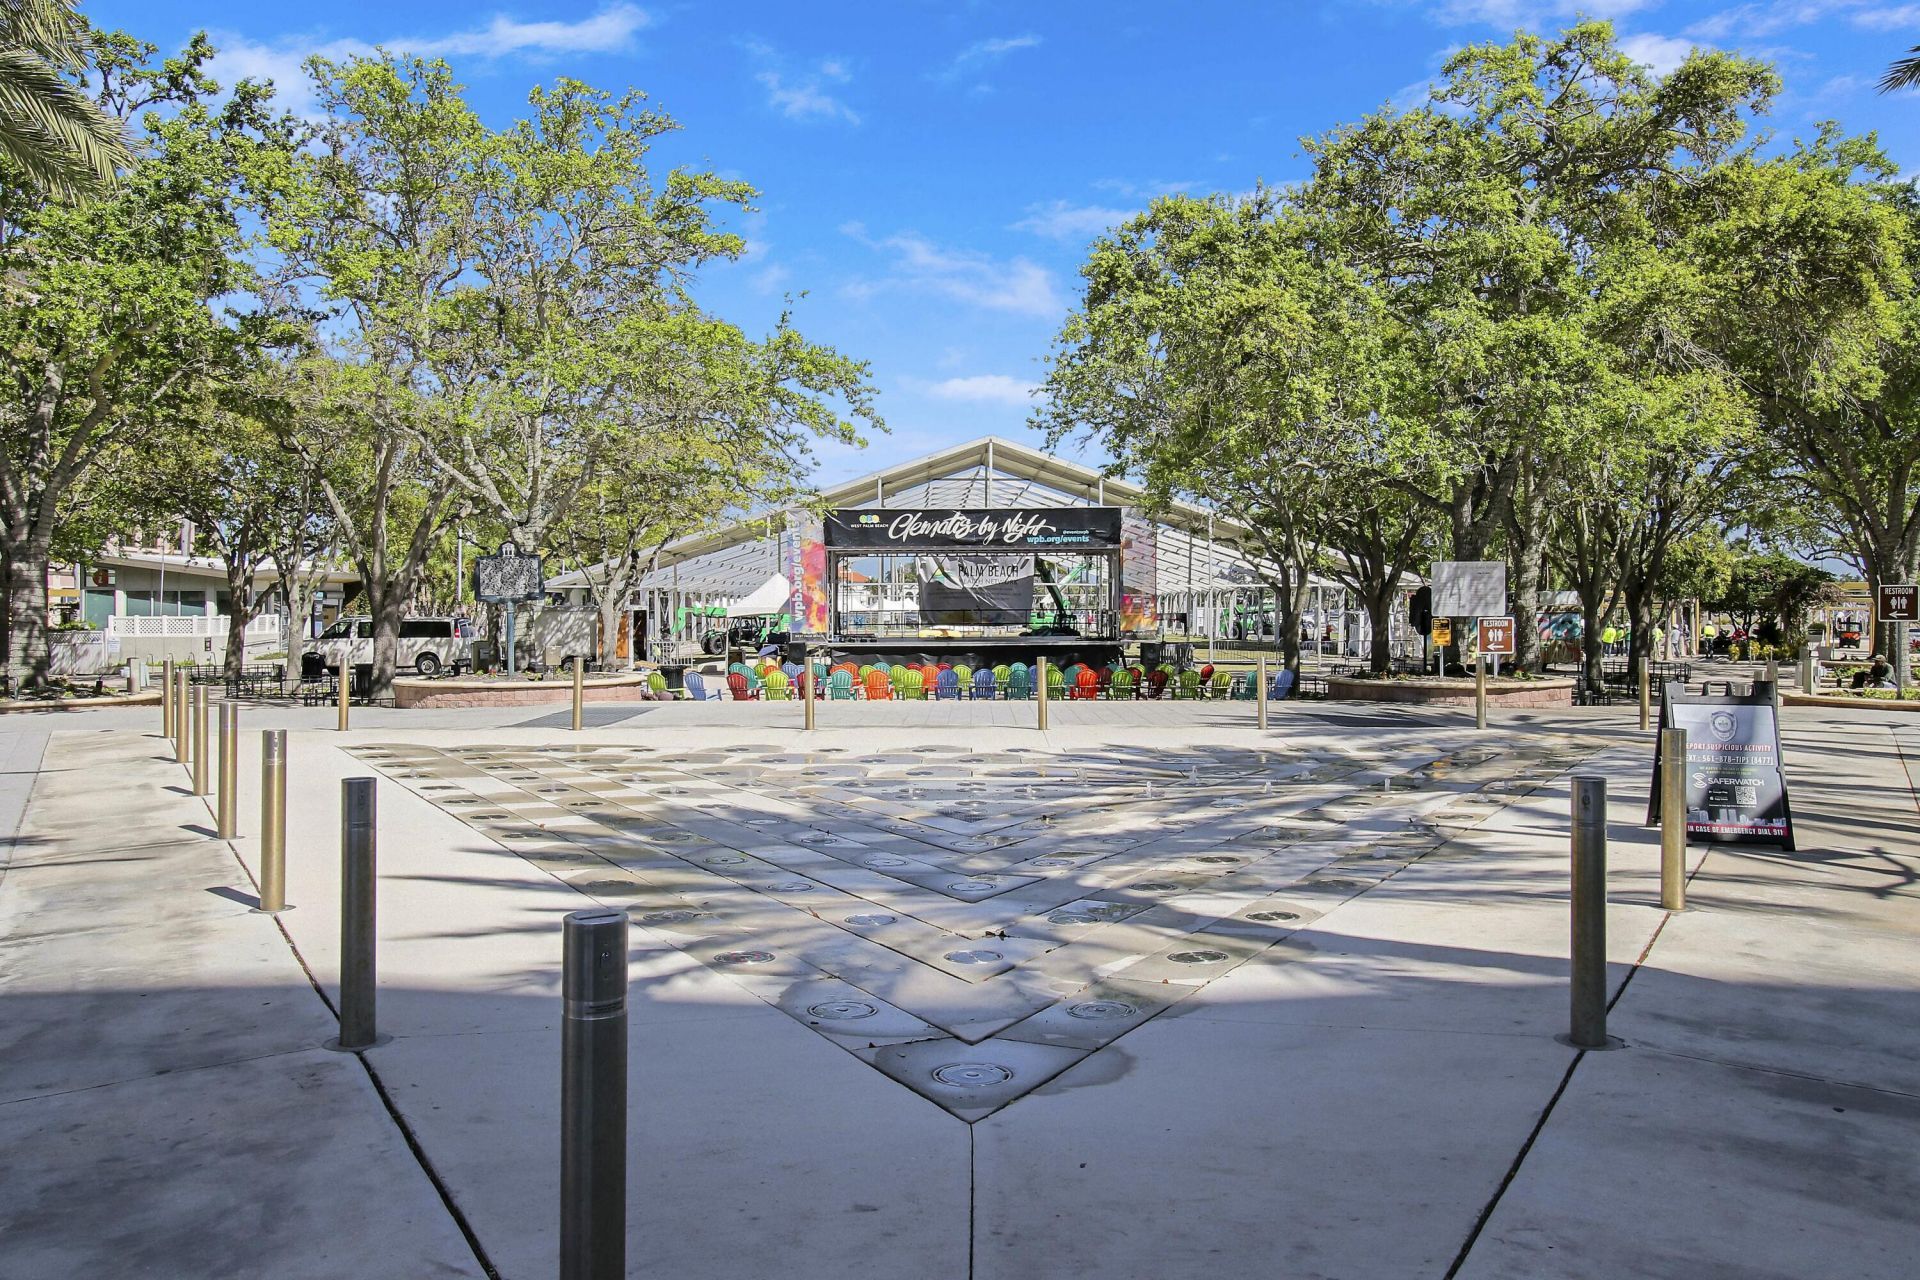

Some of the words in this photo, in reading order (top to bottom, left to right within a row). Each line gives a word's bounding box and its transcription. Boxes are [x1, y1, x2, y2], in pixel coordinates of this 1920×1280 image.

[888, 510, 979, 542] Clematis
[978, 515, 1001, 545] by
[1002, 511, 1056, 543] Night
[1026, 535, 1090, 545] wpb.org/events
[958, 564, 984, 577] PALM
[988, 564, 1019, 577] BEACH
[1885, 587, 1914, 595] RESTROOM
[1483, 620, 1509, 628] RESTROOM
[1686, 742, 1705, 750] EPORT
[1707, 743, 1743, 751] SUSPICIOUS
[1708, 777, 1765, 786] SAFERWATCH
[1695, 825, 1711, 833] CASE
[1721, 826, 1756, 835] EMERGENCY
[1773, 828, 1784, 836] 911
